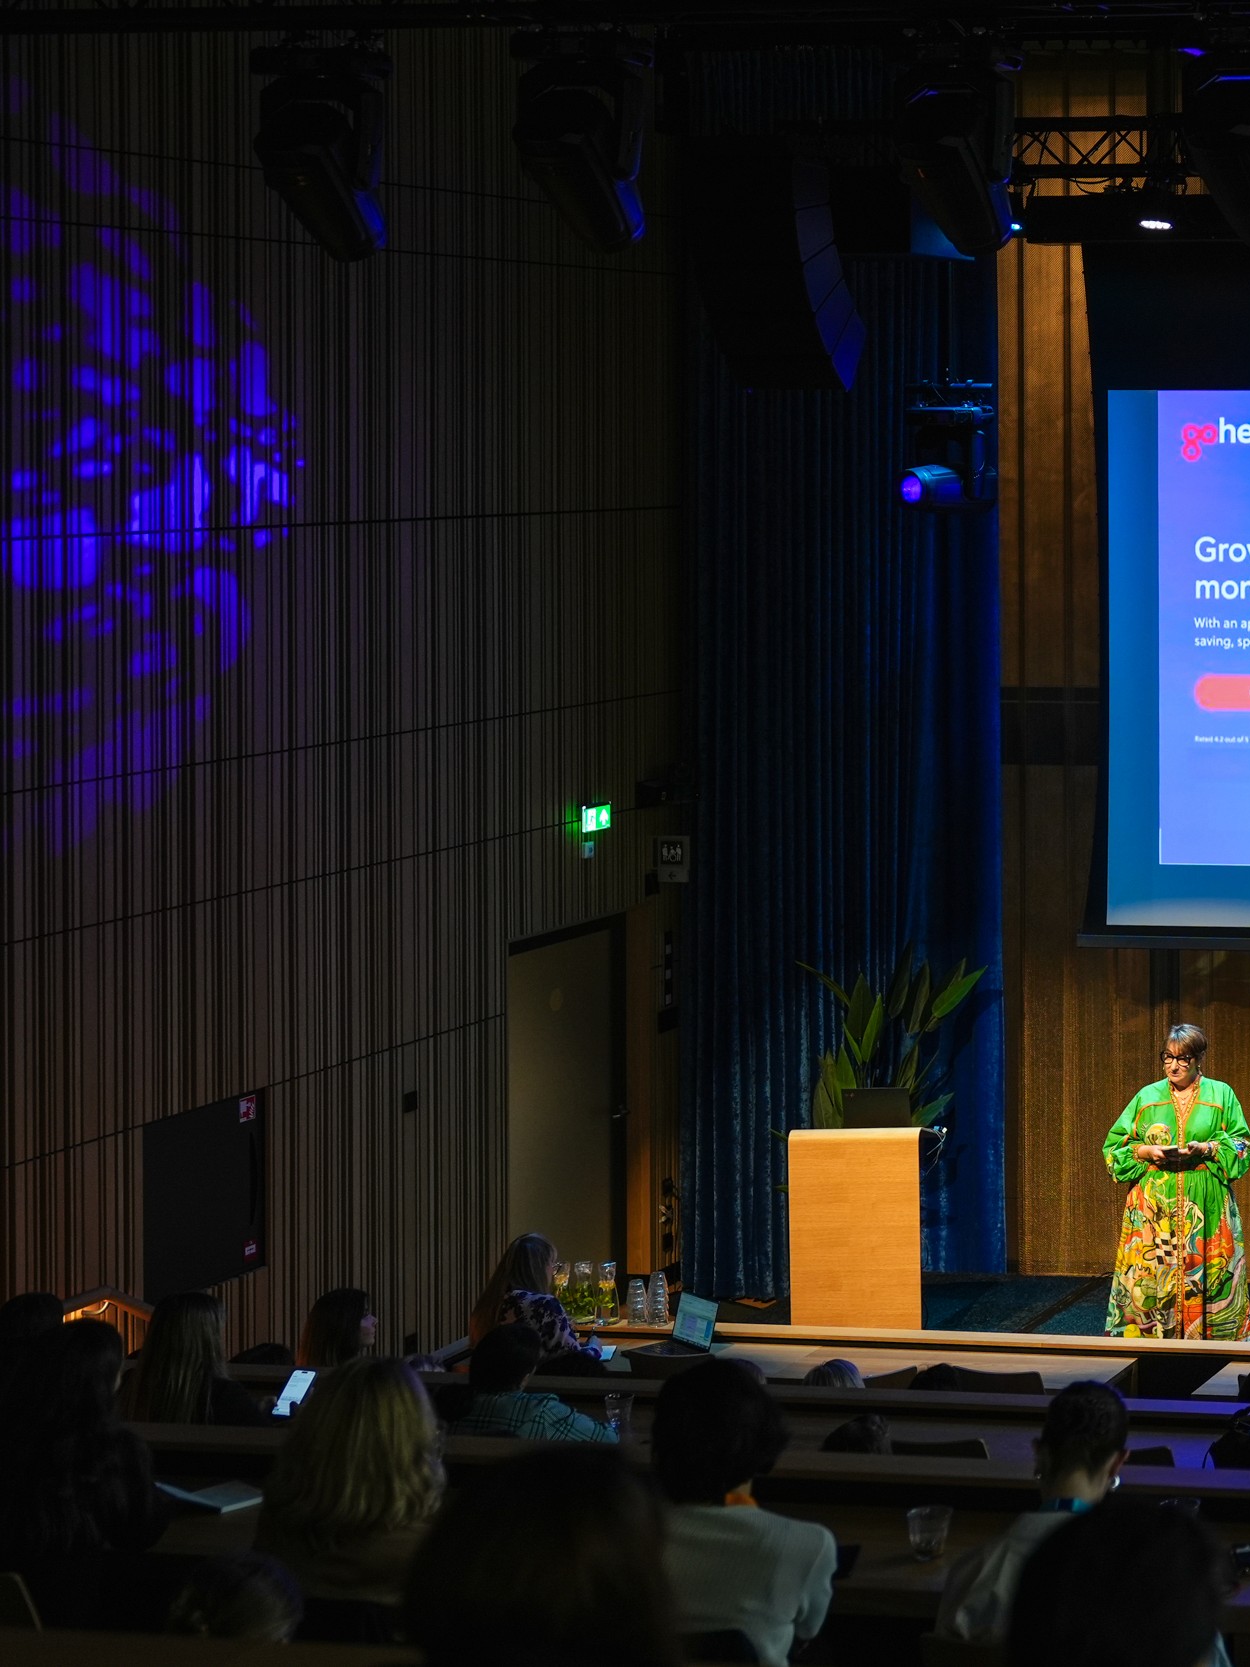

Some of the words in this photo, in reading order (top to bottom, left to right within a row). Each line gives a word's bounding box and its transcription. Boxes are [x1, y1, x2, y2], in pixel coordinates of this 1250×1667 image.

[1194, 616, 1220, 629] With
[1223, 620, 1238, 629] an
[1194, 635, 1234, 650] saving,
